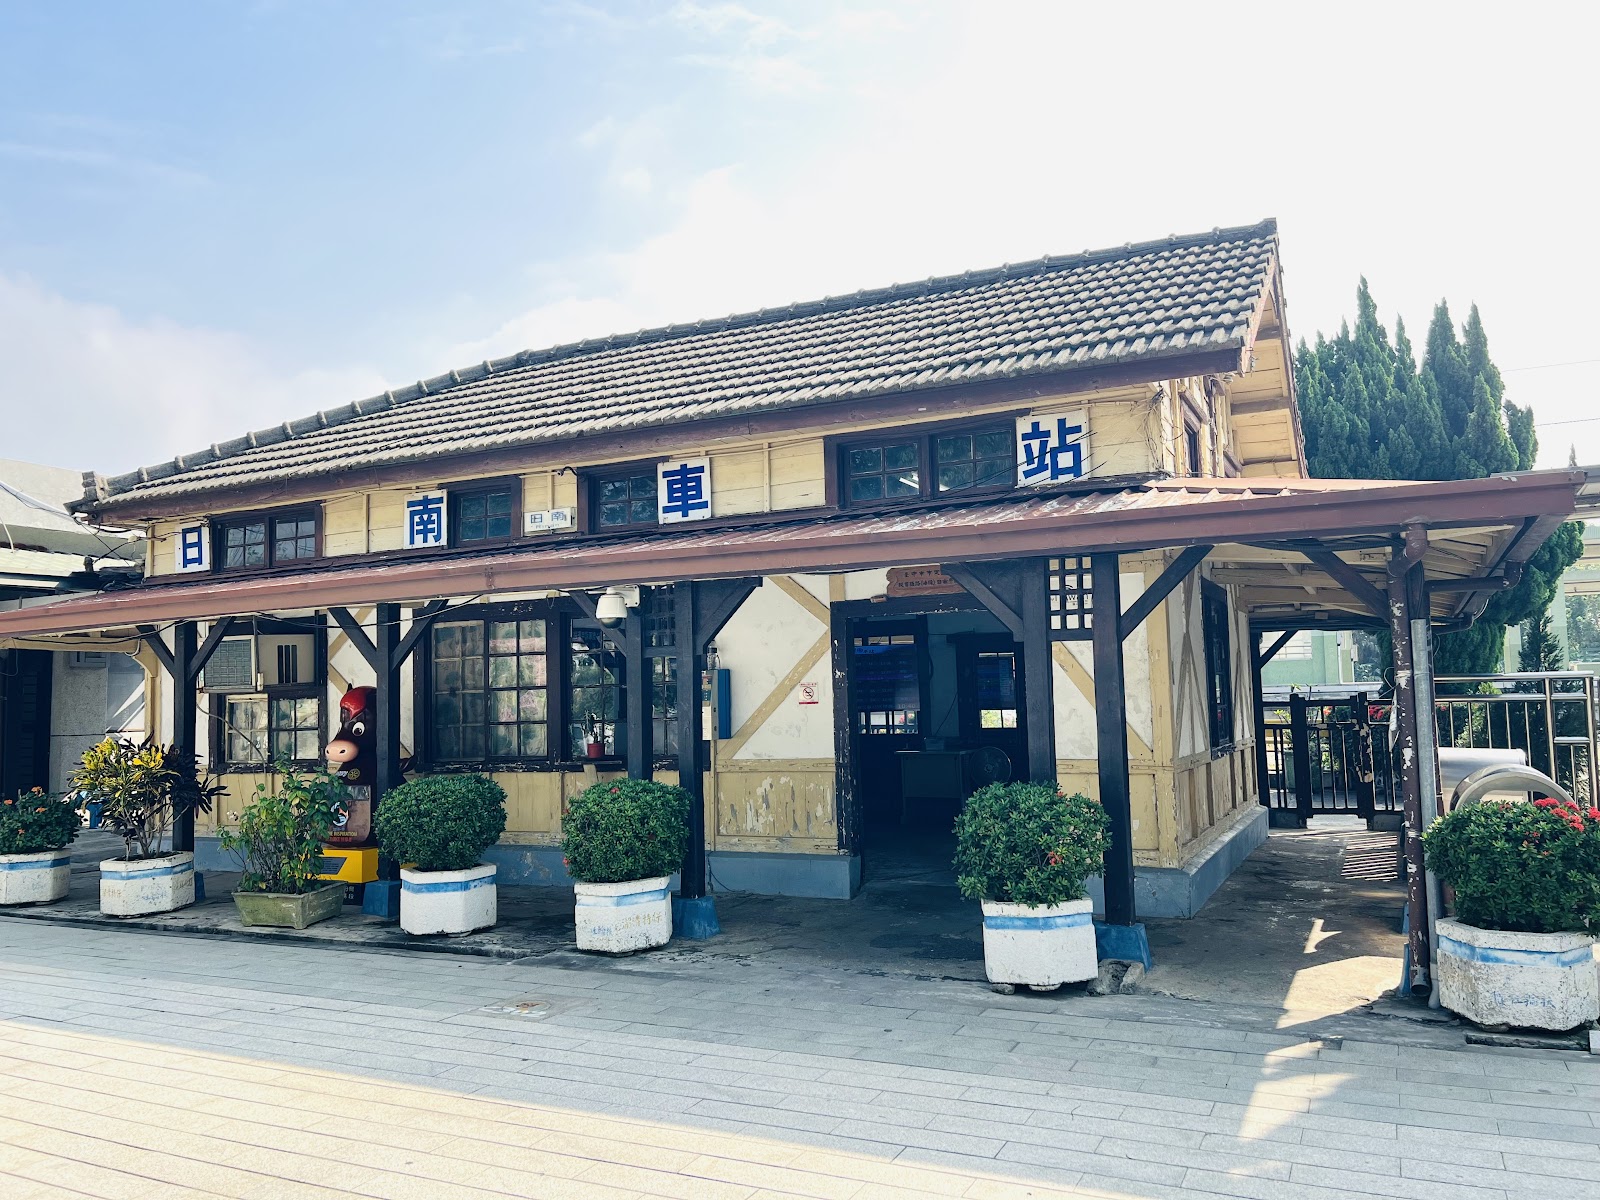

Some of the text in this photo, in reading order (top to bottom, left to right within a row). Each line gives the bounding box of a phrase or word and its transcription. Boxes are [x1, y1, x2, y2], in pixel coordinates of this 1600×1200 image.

[182, 418, 1083, 568] 日 南 車 站
[530, 511, 567, 524] 日南
